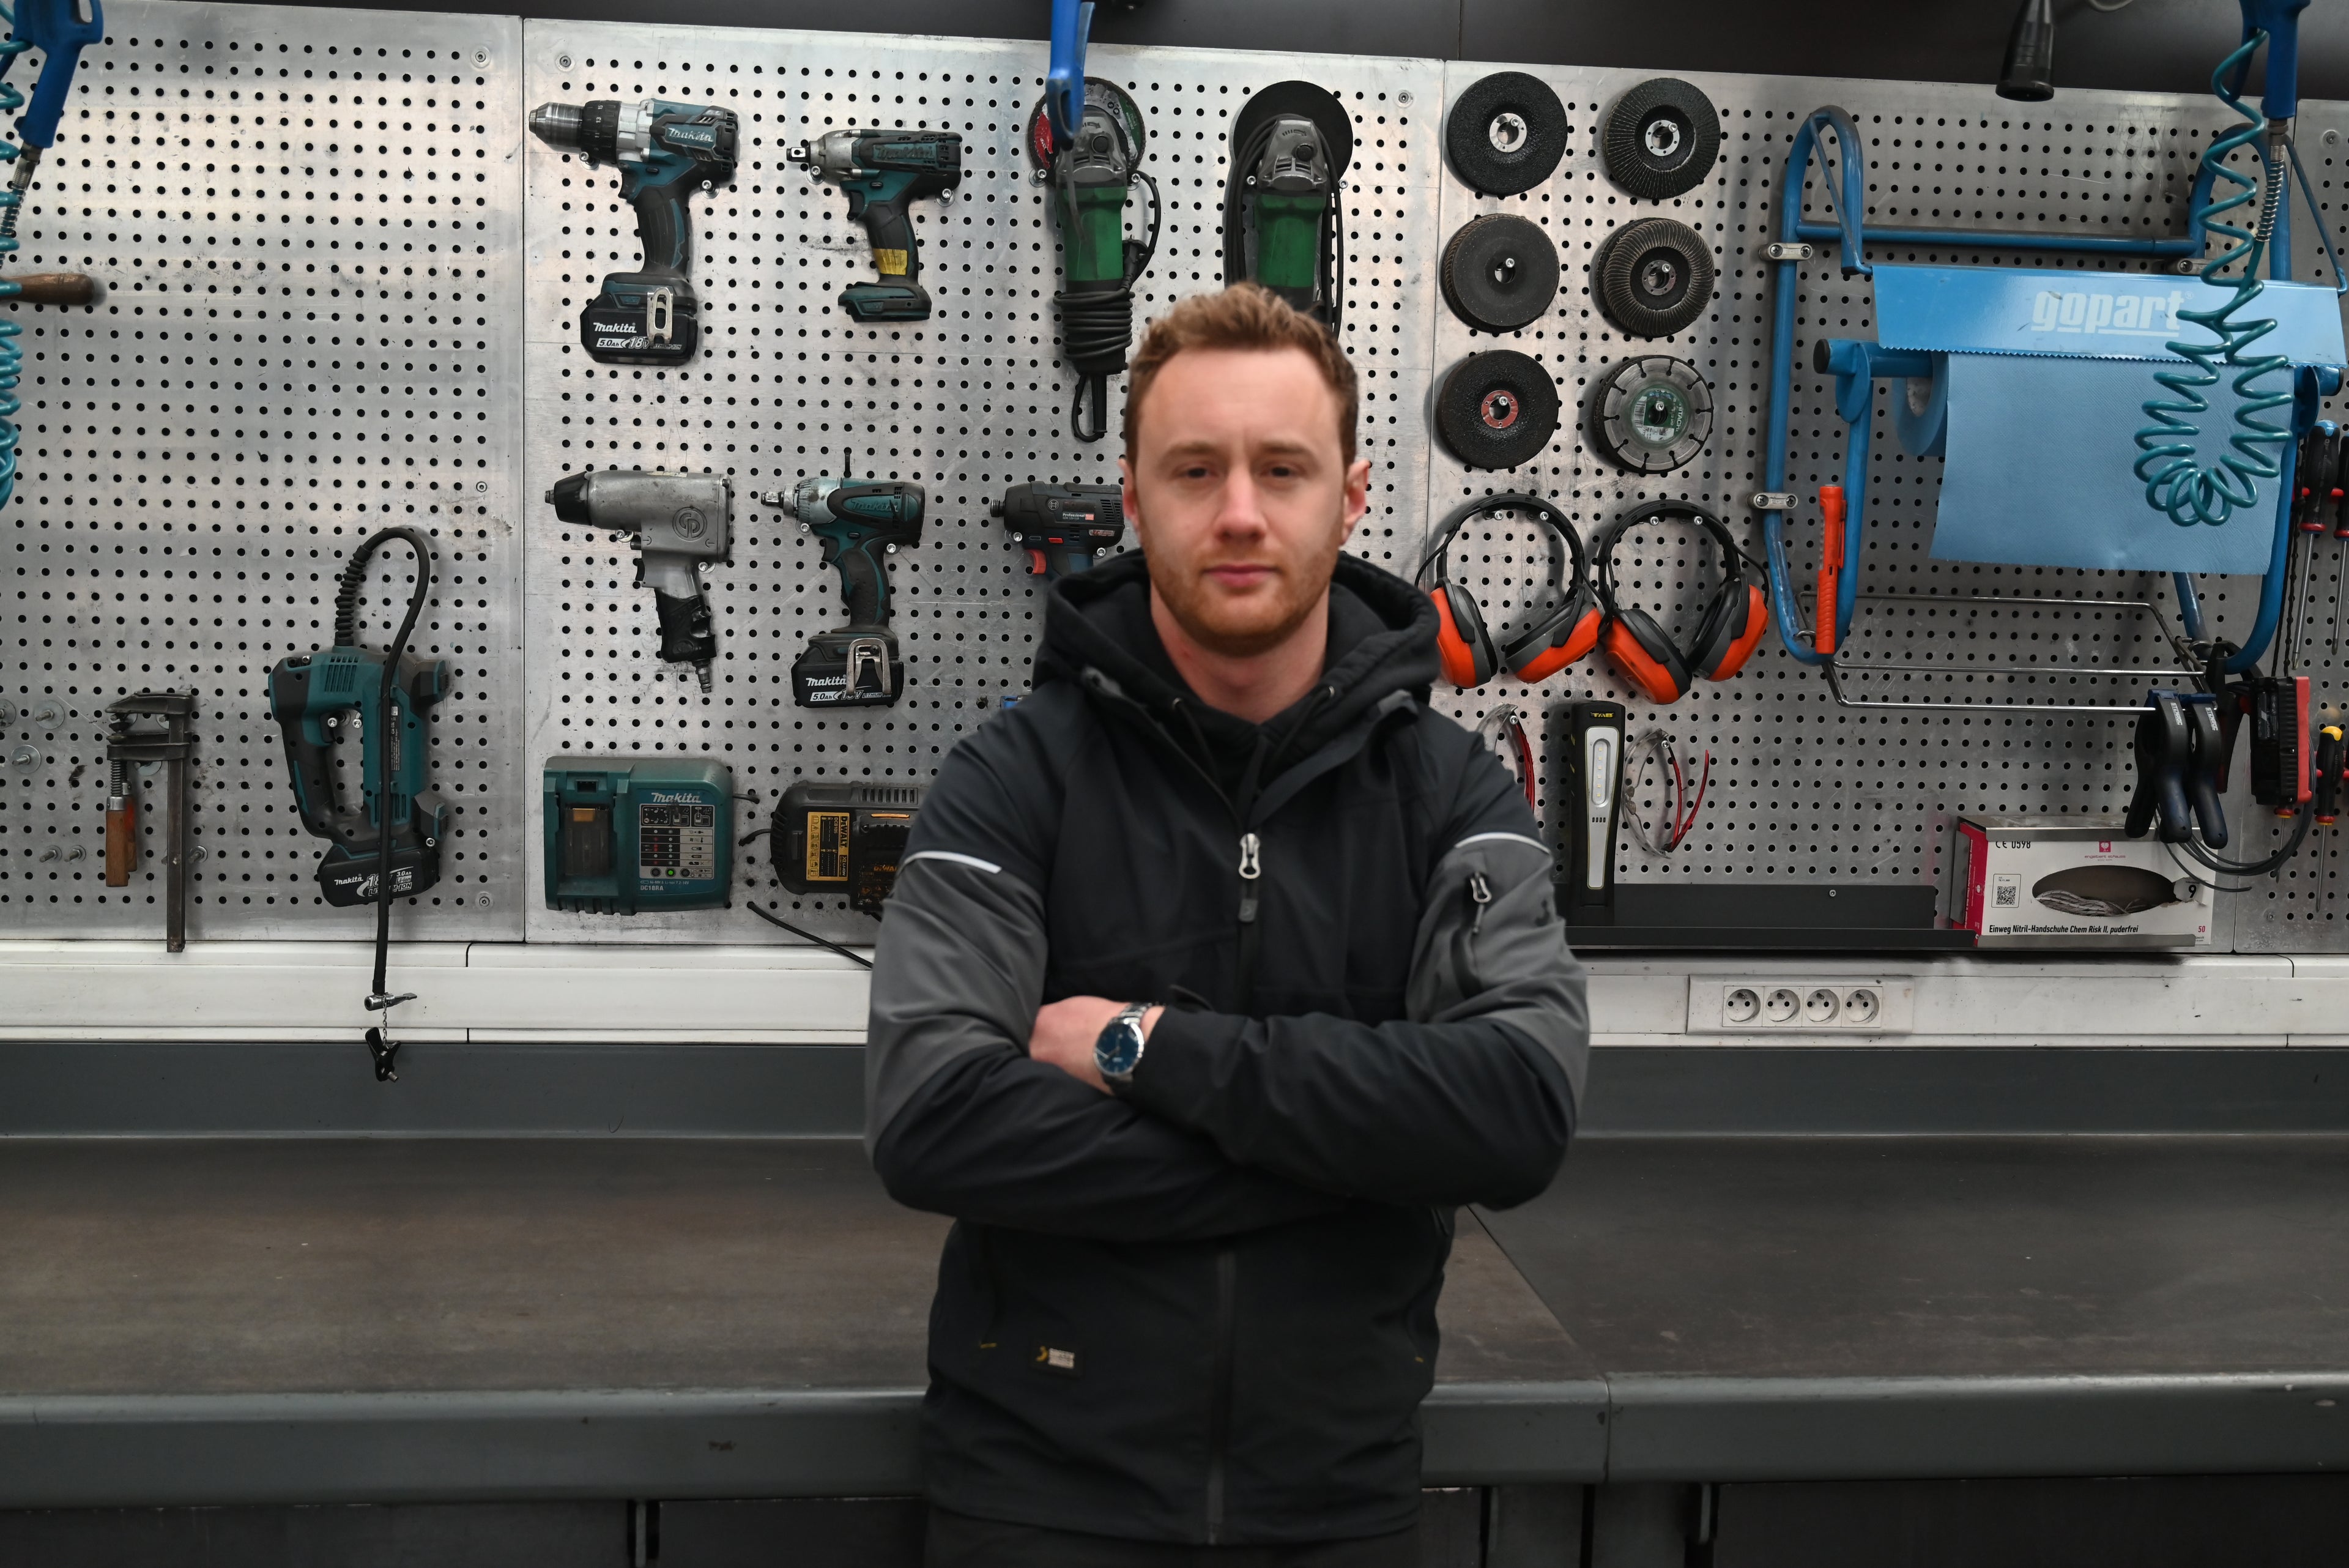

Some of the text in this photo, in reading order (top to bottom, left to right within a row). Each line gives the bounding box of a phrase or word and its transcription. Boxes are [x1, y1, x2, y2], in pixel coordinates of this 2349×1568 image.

[2031, 291, 2184, 335] gopart
[2188, 884, 2197, 898] 9
[1989, 925, 2011, 934] Einweg
[2110, 925, 2139, 934] puderfrei
